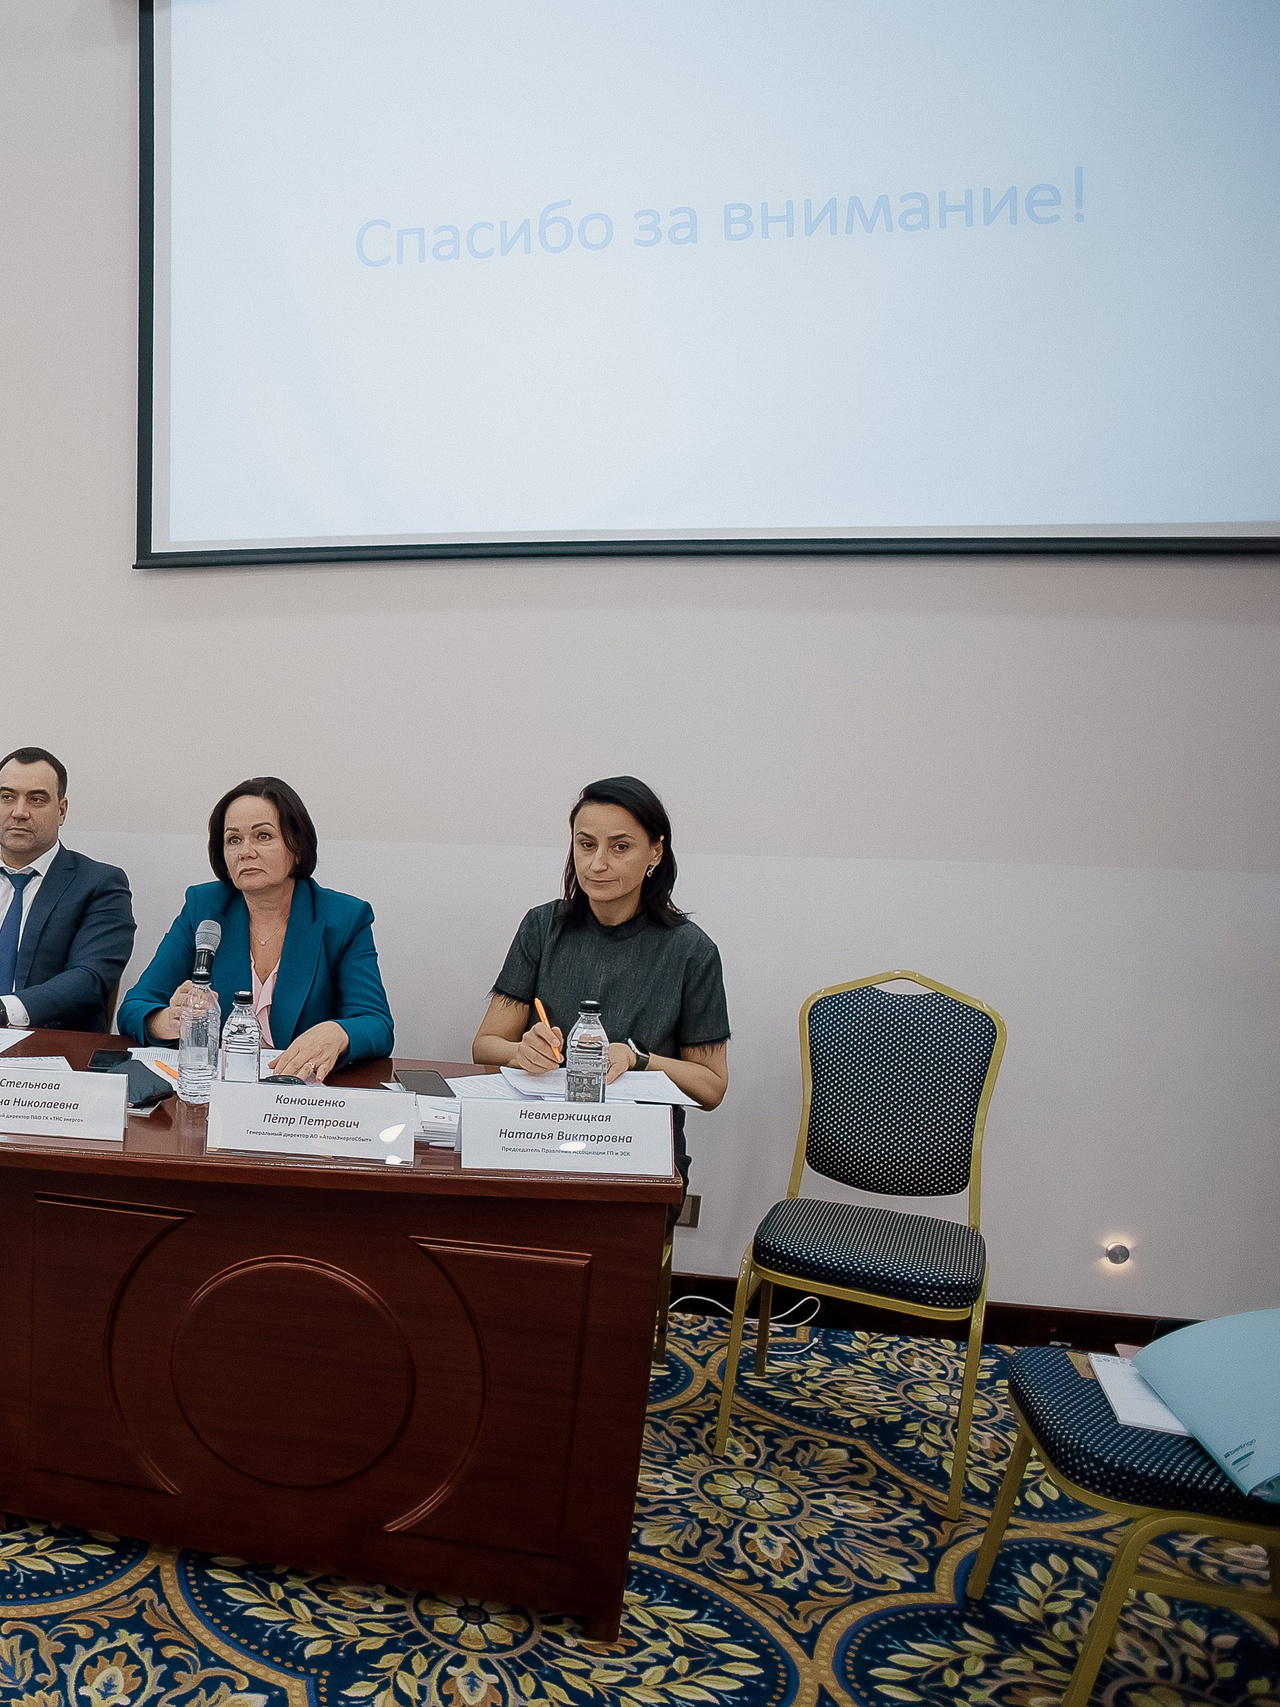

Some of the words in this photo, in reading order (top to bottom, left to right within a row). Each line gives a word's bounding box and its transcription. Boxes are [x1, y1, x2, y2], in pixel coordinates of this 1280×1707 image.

[355, 199, 614, 268] Спасибо
[632, 205, 700, 248] за
[722, 166, 1085, 242] внимание!
[0, 1078, 61, 1090] Стельнова
[12, 1097, 79, 1111] Николаевна
[275, 1094, 346, 1108] Конюшенко
[263, 1113, 296, 1127] Пётр
[298, 1115, 360, 1129] Петрович
[519, 1109, 612, 1123] Невмержицкая
[246, 1129, 282, 1137] Генеральный
[319, 1134, 372, 1142] «АтомЭнергоСбыт»
[498, 1128, 554, 1141] Наталья
[557, 1131, 633, 1144] Викторовна
